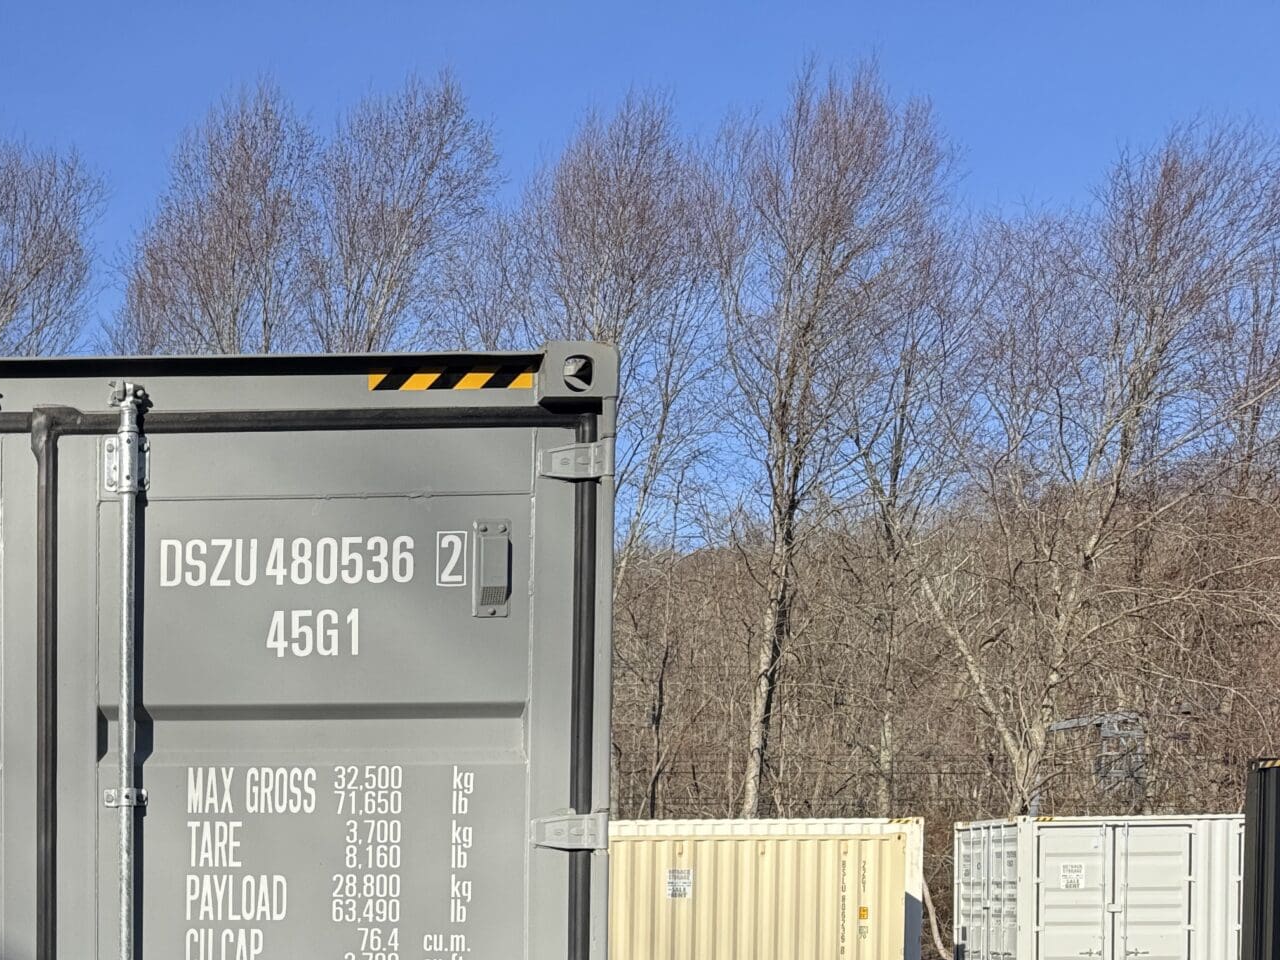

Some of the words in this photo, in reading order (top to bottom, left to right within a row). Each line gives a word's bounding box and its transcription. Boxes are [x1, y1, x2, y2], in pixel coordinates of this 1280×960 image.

[160, 538, 258, 587] DSZU
[265, 535, 415, 586] 480536
[440, 534, 463, 583] 2
[266, 608, 360, 658] 45G1
[187, 767, 235, 813] MAX
[246, 767, 317, 814] GROSS
[334, 765, 402, 791] 32,500
[452, 765, 474, 793] kg
[335, 790, 402, 815] 71,650
[452, 790, 468, 814] lb
[187, 821, 243, 867] TARE
[345, 820, 401, 845] 3,700
[451, 820, 473, 848] kg
[345, 845, 401, 869] 8,160
[451, 845, 468, 868] lb
[186, 874, 288, 921] PAYLOAD
[332, 874, 401, 899] 28,800
[451, 874, 472, 902] kg
[332, 899, 400, 923] 63,490
[450, 899, 467, 922] lb
[357, 928, 399, 952] 76.4
[423, 933, 471, 952] cu.m.
